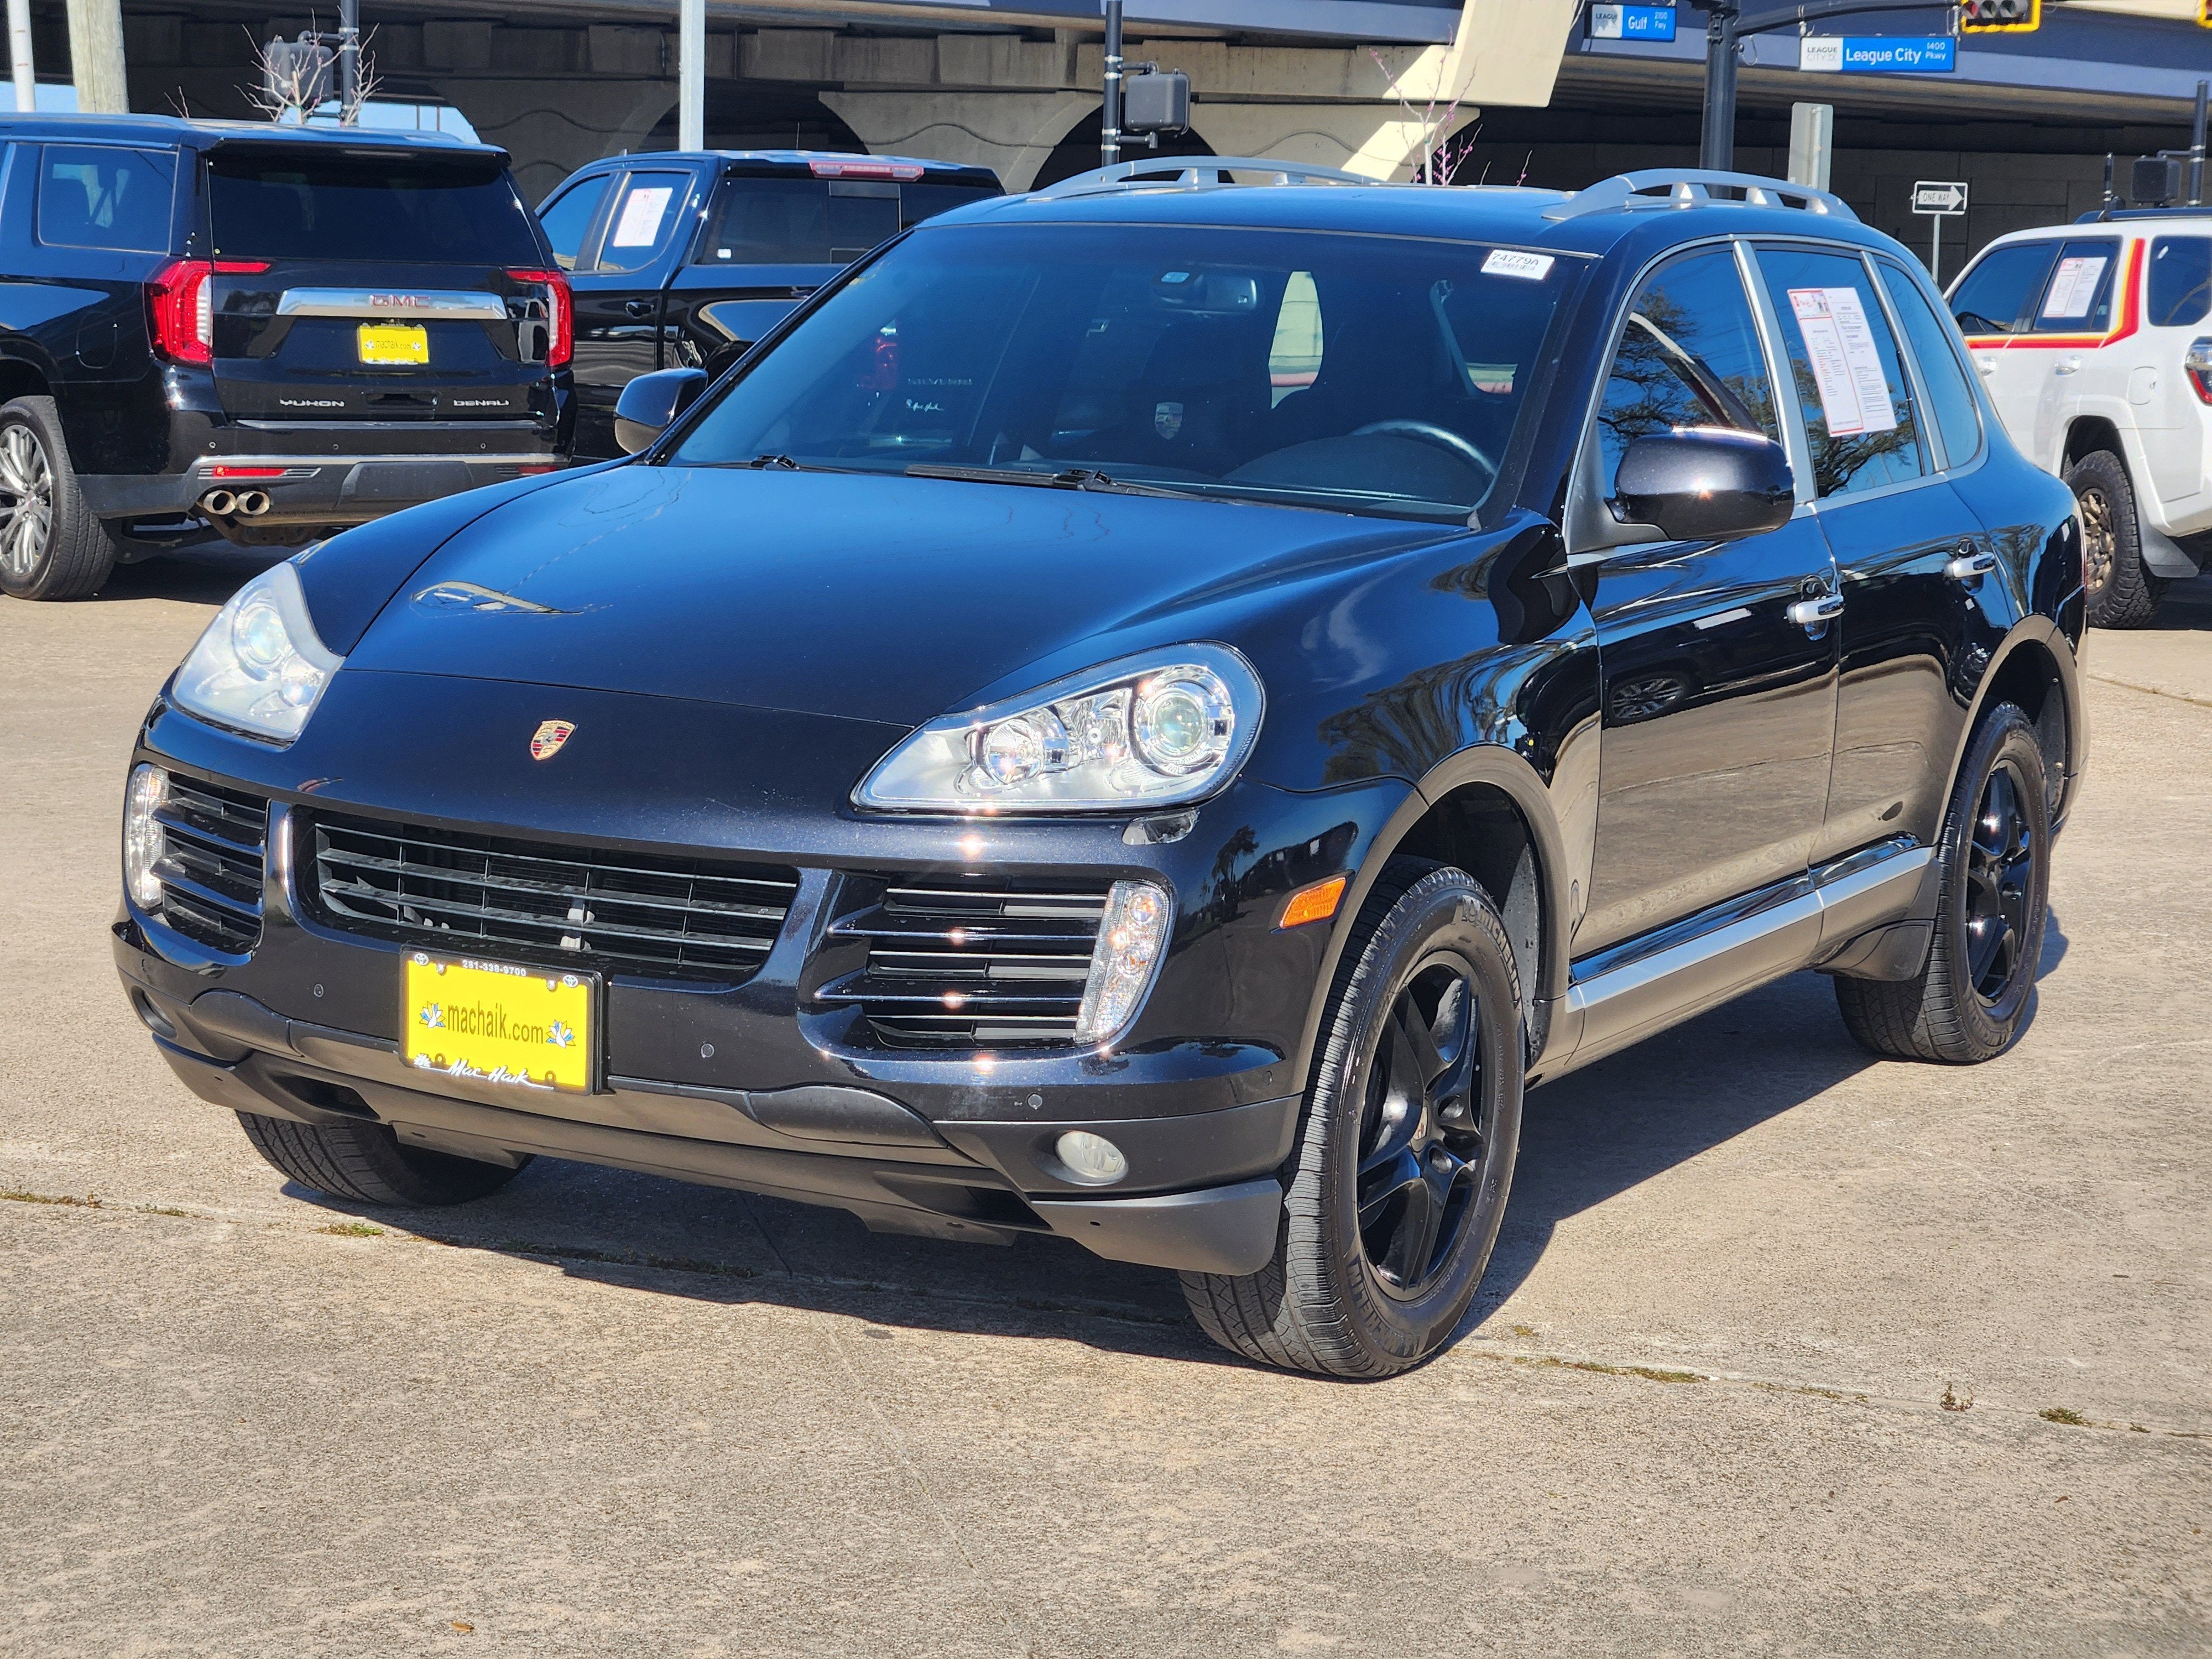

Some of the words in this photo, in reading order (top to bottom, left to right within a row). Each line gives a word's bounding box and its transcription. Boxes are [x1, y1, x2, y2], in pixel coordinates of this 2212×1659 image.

[1628, 15, 1647, 30] Gulf
[1927, 41, 1945, 50] 1400
[1845, 48, 1892, 65] League
[1895, 48, 1922, 64] City
[1925, 51, 1946, 61] Pkwy
[1923, 192, 1935, 202] ONE
[1938, 192, 1950, 201] WAY
[369, 294, 430, 308] GMC
[1478, 907, 1521, 1000] MICHELIN
[462, 959, 527, 977] 281-338-9700
[447, 1000, 544, 1044] machaik.com
[447, 1057, 487, 1079] Mac
[487, 1065, 545, 1087] Haik
